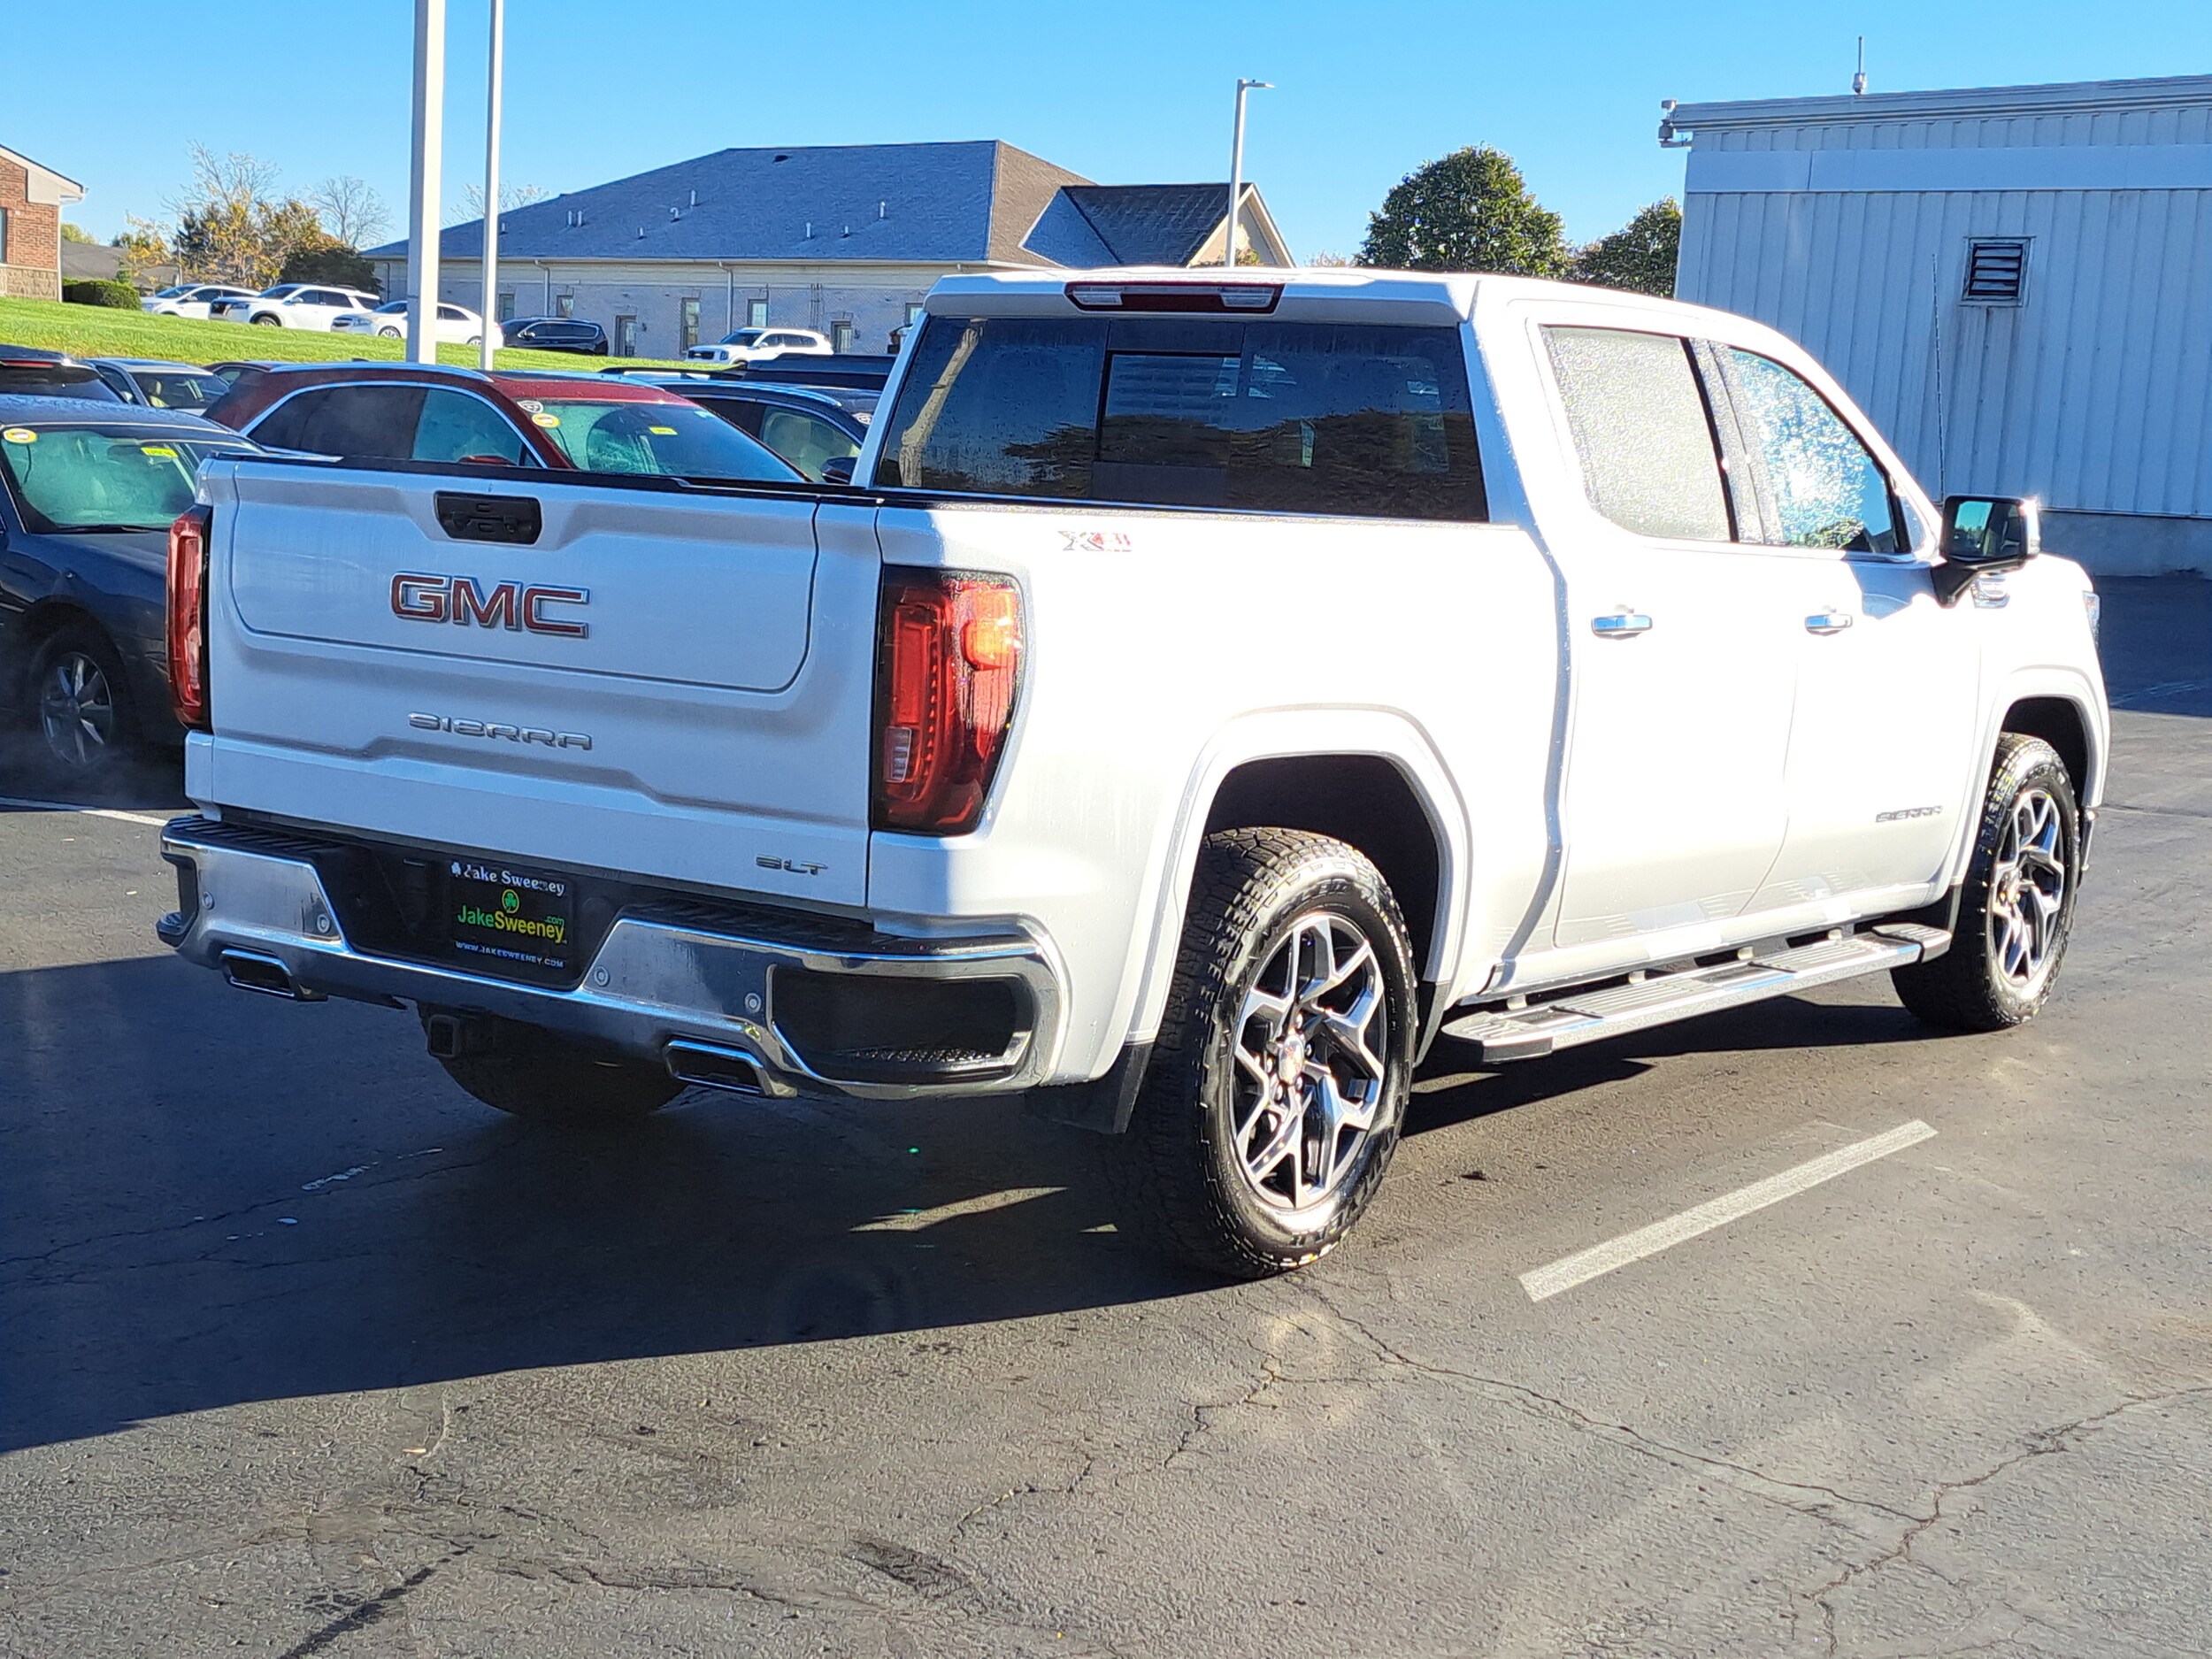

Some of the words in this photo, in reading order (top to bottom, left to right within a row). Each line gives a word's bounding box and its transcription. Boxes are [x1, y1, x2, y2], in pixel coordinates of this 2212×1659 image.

[390, 571, 589, 639] GMC
[408, 711, 592, 750] SIERRA
[755, 854, 828, 876] SLT
[457, 904, 565, 944] JakeSweeney
